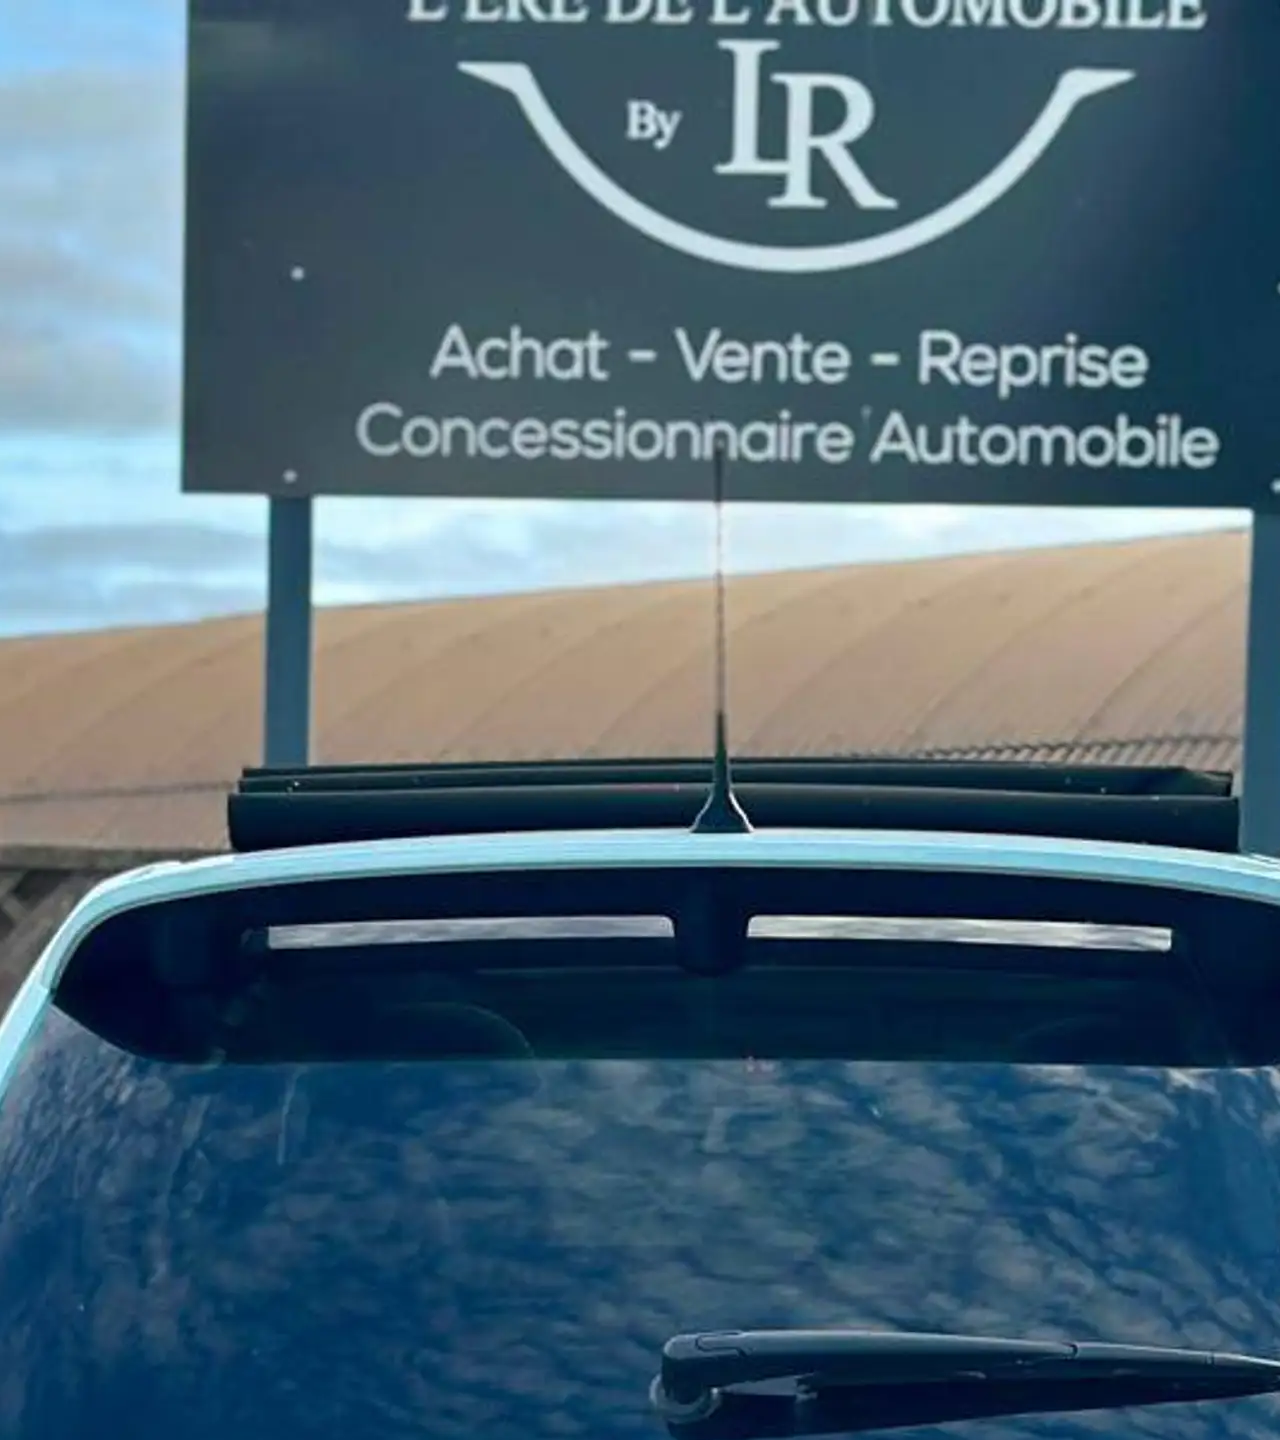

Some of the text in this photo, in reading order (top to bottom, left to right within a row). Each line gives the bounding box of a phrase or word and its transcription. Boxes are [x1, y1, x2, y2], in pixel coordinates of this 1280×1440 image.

[710, 0, 1208, 29] LAUTOMOBILE
[626, 99, 682, 150] By
[429, 323, 611, 381] Achat
[675, 326, 852, 385] Vente
[919, 328, 1149, 400] Reprise
[356, 401, 1220, 469] Concessionnaire Automobile
